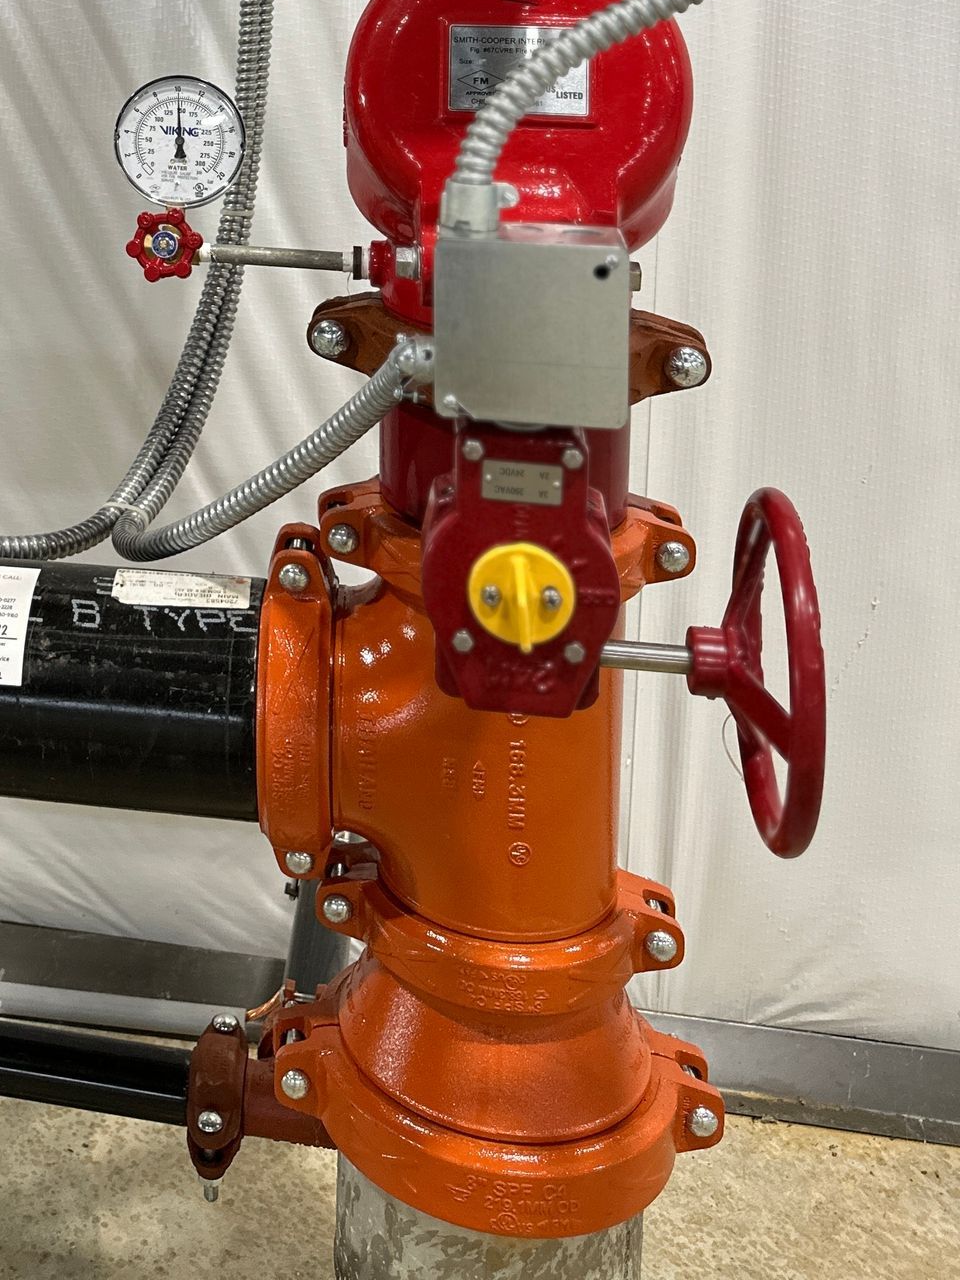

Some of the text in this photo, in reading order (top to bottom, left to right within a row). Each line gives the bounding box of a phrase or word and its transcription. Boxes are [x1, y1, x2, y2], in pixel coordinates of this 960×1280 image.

[453, 36, 516, 45] SMITH-COOPER
[473, 77, 489, 85] FM
[198, 90, 206, 98] 12
[556, 92, 583, 100] LISTED
[228, 151, 236, 159] 18
[217, 171, 226, 181] 20
[71, 598, 258, 633] B TYPE
[492, 1180, 533, 1197] SPF
